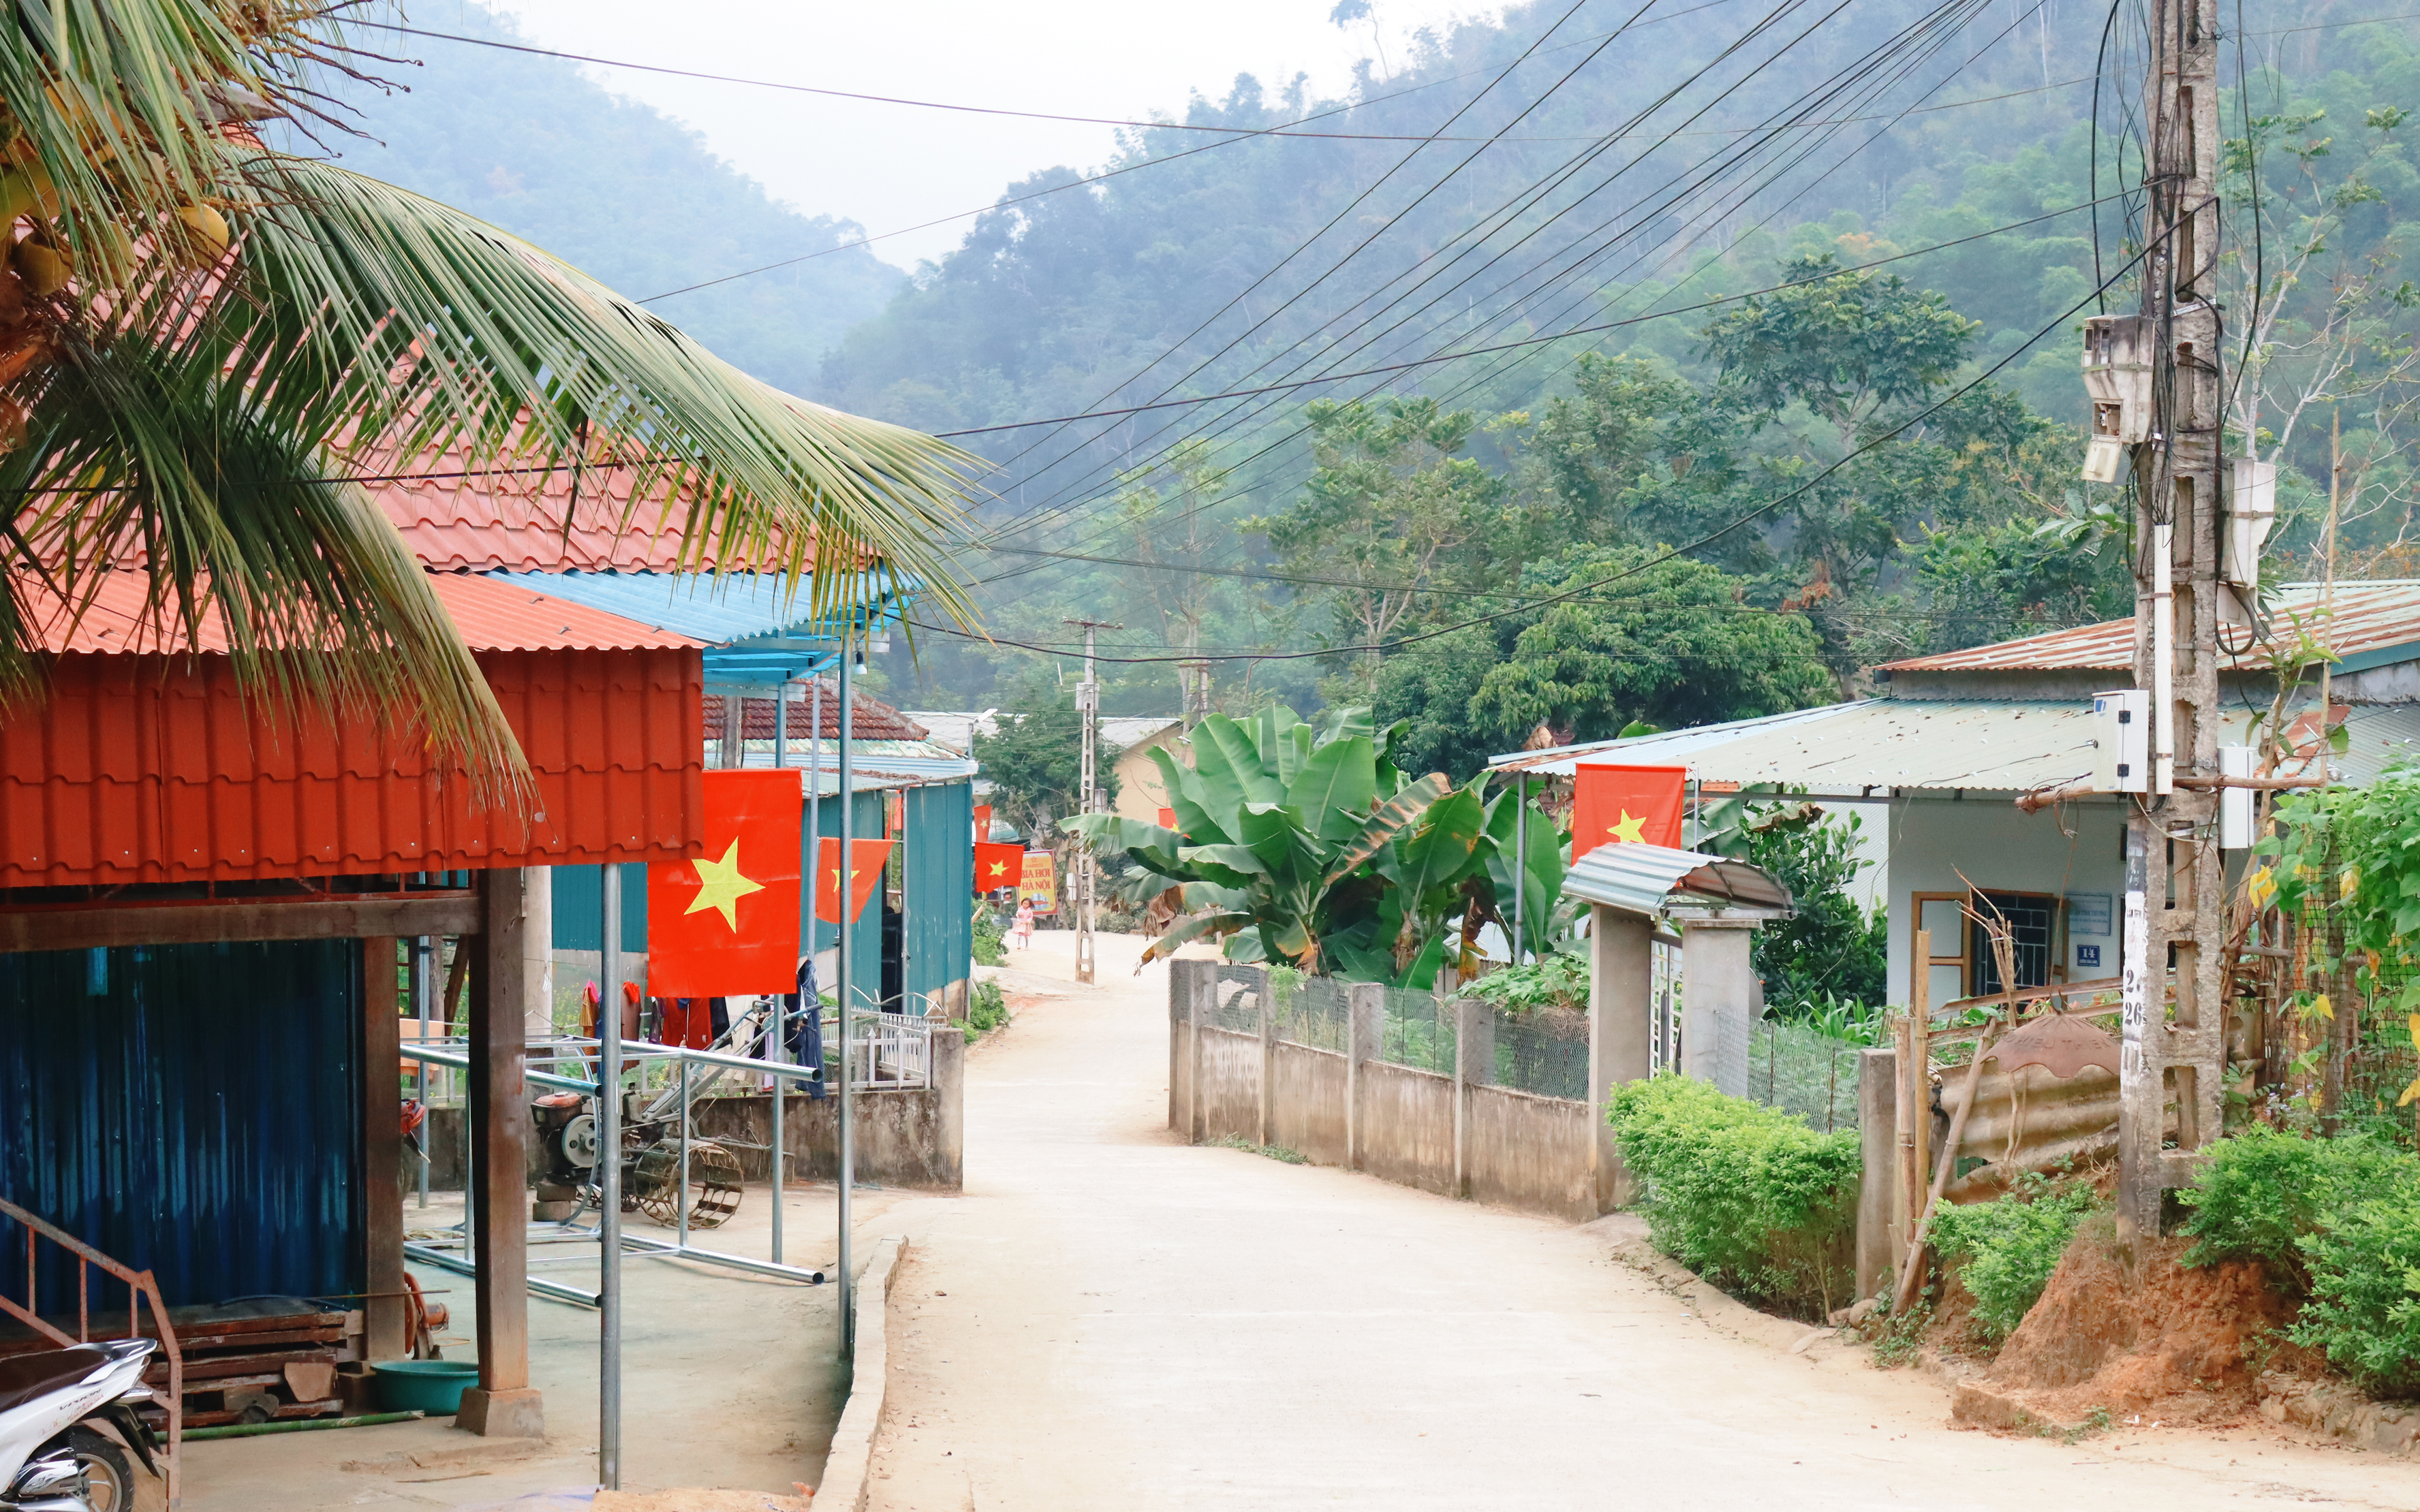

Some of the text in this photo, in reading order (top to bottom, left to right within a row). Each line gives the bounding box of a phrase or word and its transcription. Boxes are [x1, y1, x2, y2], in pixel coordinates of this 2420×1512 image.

[1021, 869, 1034, 879] BIA
[1022, 879, 1051, 892] HÀ NỘI
[2083, 947, 2095, 958] 14
[2125, 1001, 2142, 1026] 26
